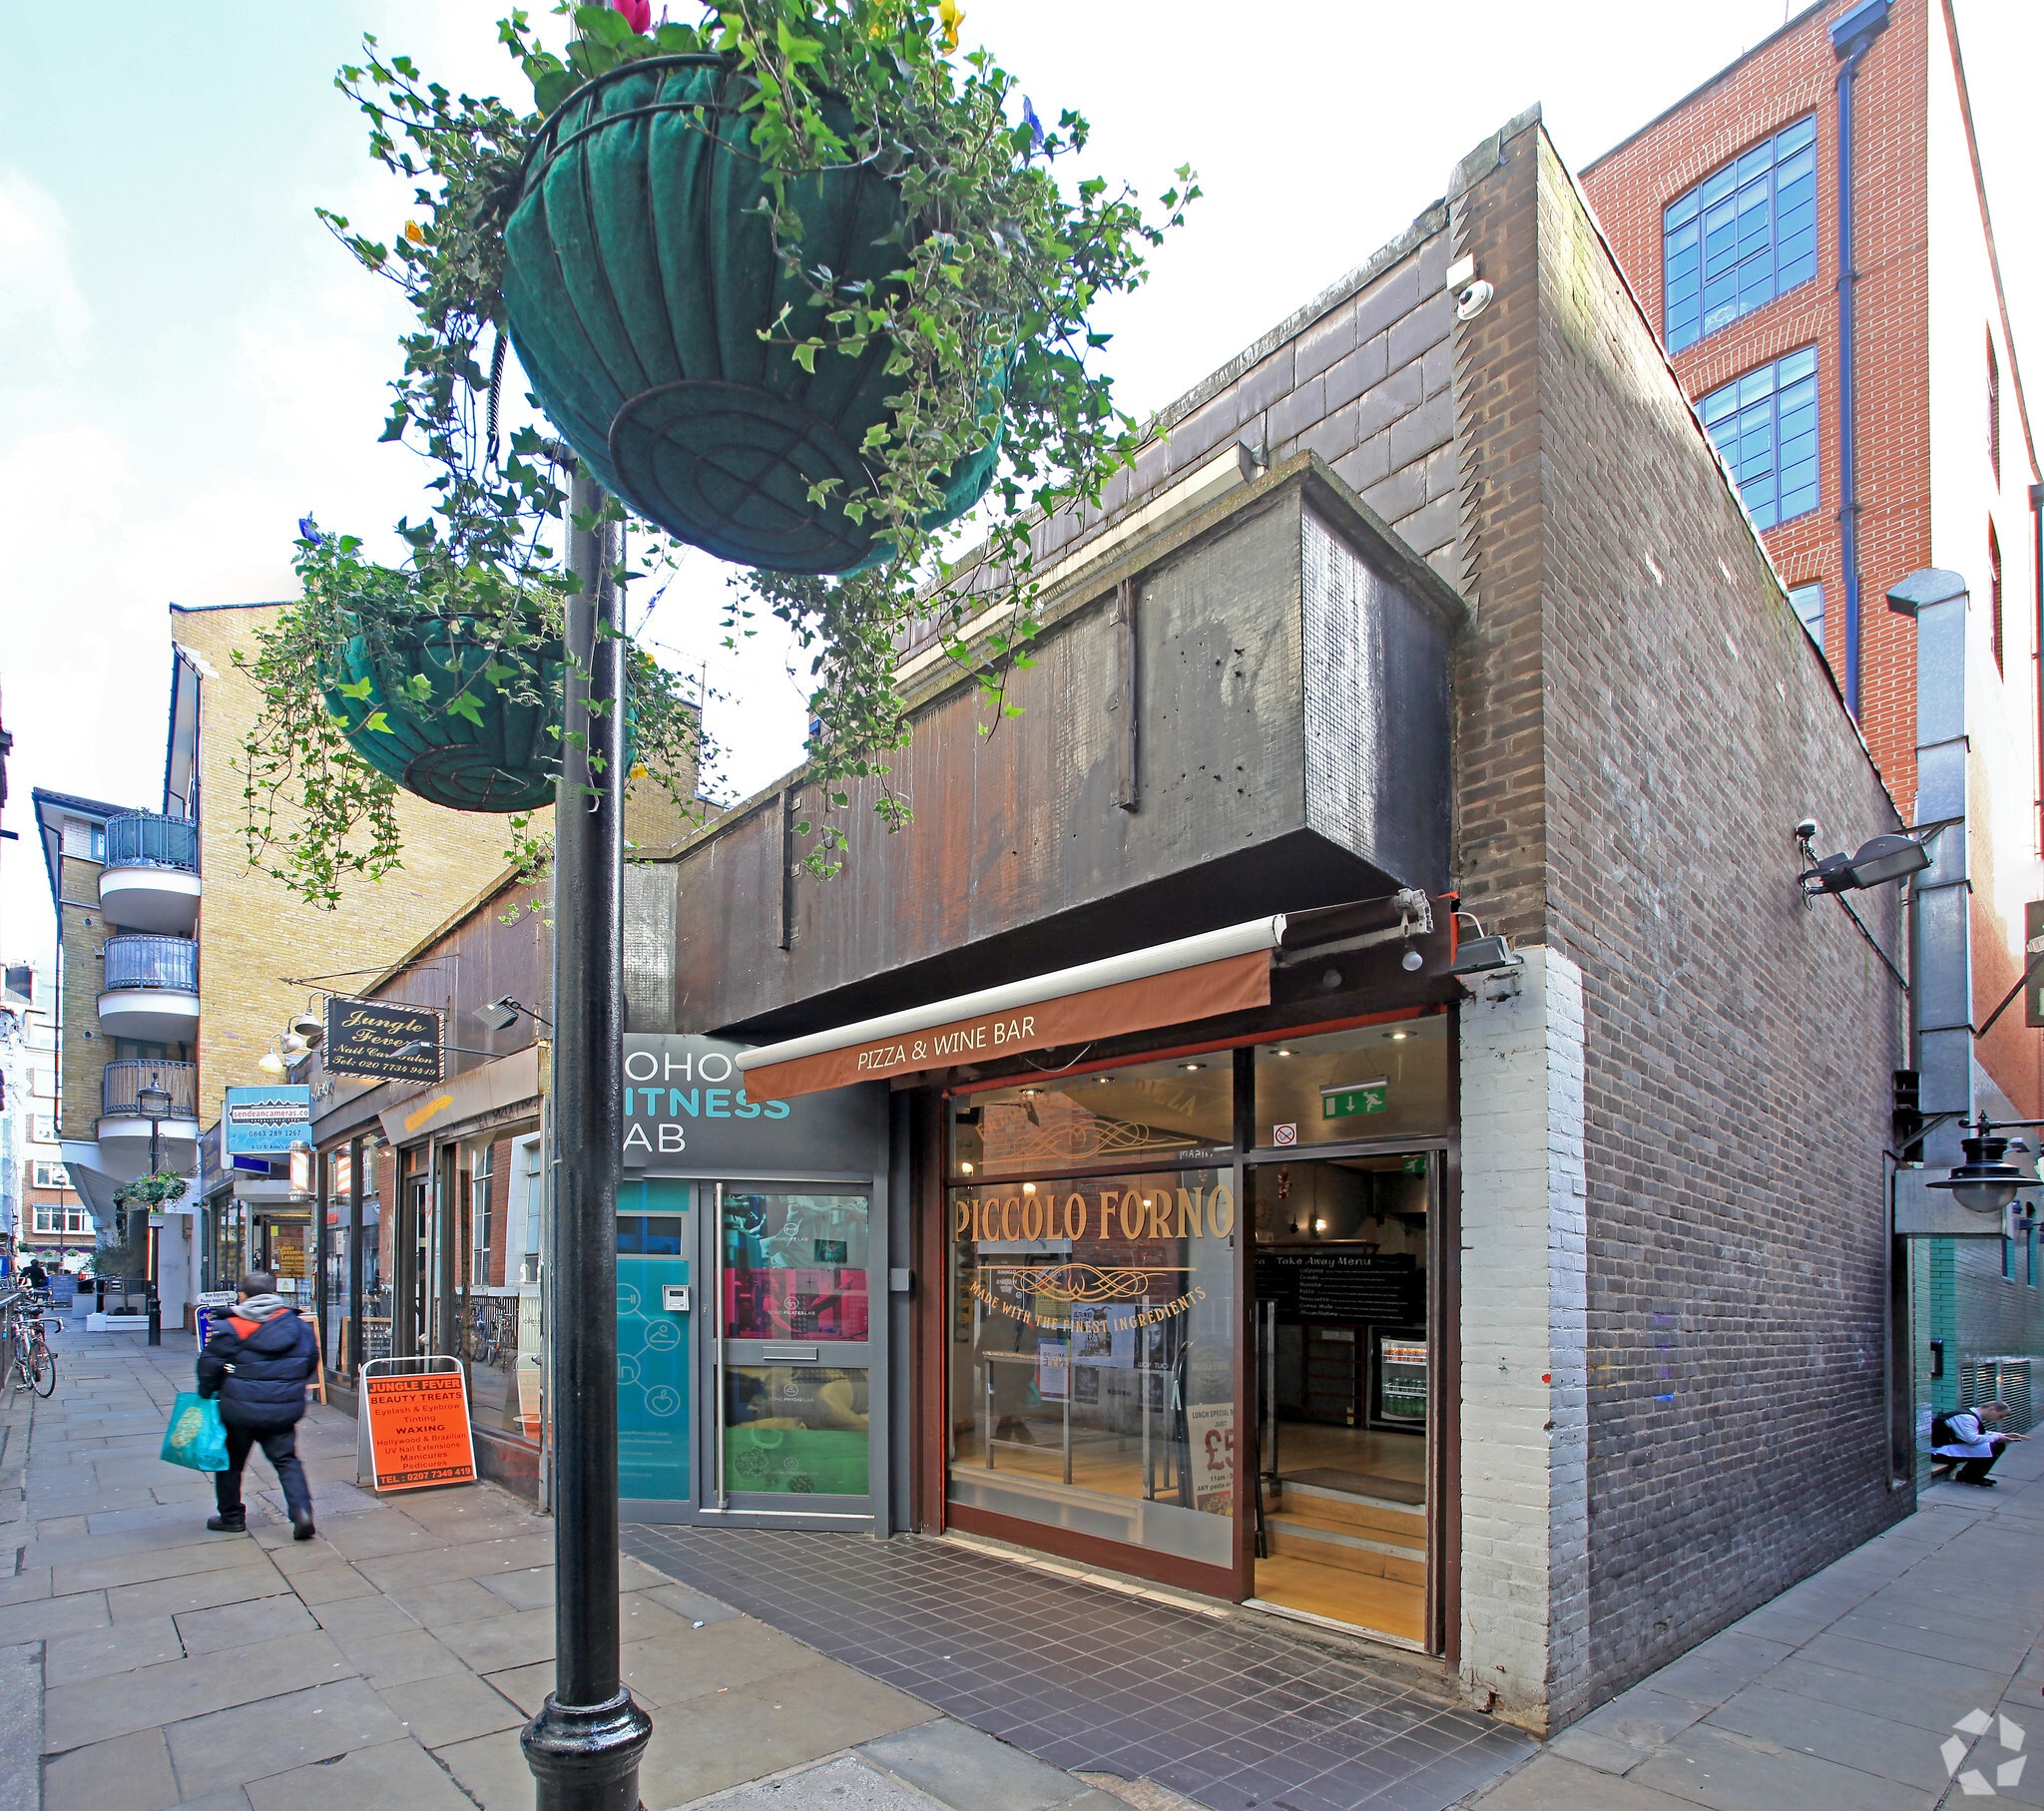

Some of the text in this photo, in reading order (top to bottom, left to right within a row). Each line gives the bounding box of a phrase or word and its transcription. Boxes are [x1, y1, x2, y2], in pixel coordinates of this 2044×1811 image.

[341, 1010, 427, 1035] Jungle
[351, 1028, 410, 1047] Fever
[858, 1016, 1036, 1071] PIZZA & WINE BAR
[333, 1044, 364, 1056] Nail
[367, 1048, 393, 1060] Car
[332, 1056, 356, 1066] Tel:
[358, 1060, 379, 1069] 020
[625, 1052, 733, 1082] OHO
[625, 1087, 790, 1120] ITNESS
[623, 1123, 687, 1153] AB
[952, 1183, 1235, 1243] PICCOLO FORNO
[1305, 1257, 1335, 1267] Away
[970, 1281, 999, 1309] MADE
[1002, 1302, 1031, 1324] WITH
[1036, 1315, 1059, 1331] THE
[1063, 1319, 1108, 1333] FINEST
[1114, 1285, 1207, 1332] INGREDIENTS
[369, 1379, 461, 1393] JUNGLE FEVER
[371, 1392, 462, 1405] BEAUTY TREATS
[375, 1407, 410, 1416] Eyelash
[423, 1403, 460, 1413] Eyebrow
[395, 1424, 445, 1435] WAXING
[377, 1437, 421, 1446] Hollywood
[379, 1475, 399, 1484] TEL
[407, 1471, 428, 1481] 0207
[431, 1469, 452, 1478] 7349
